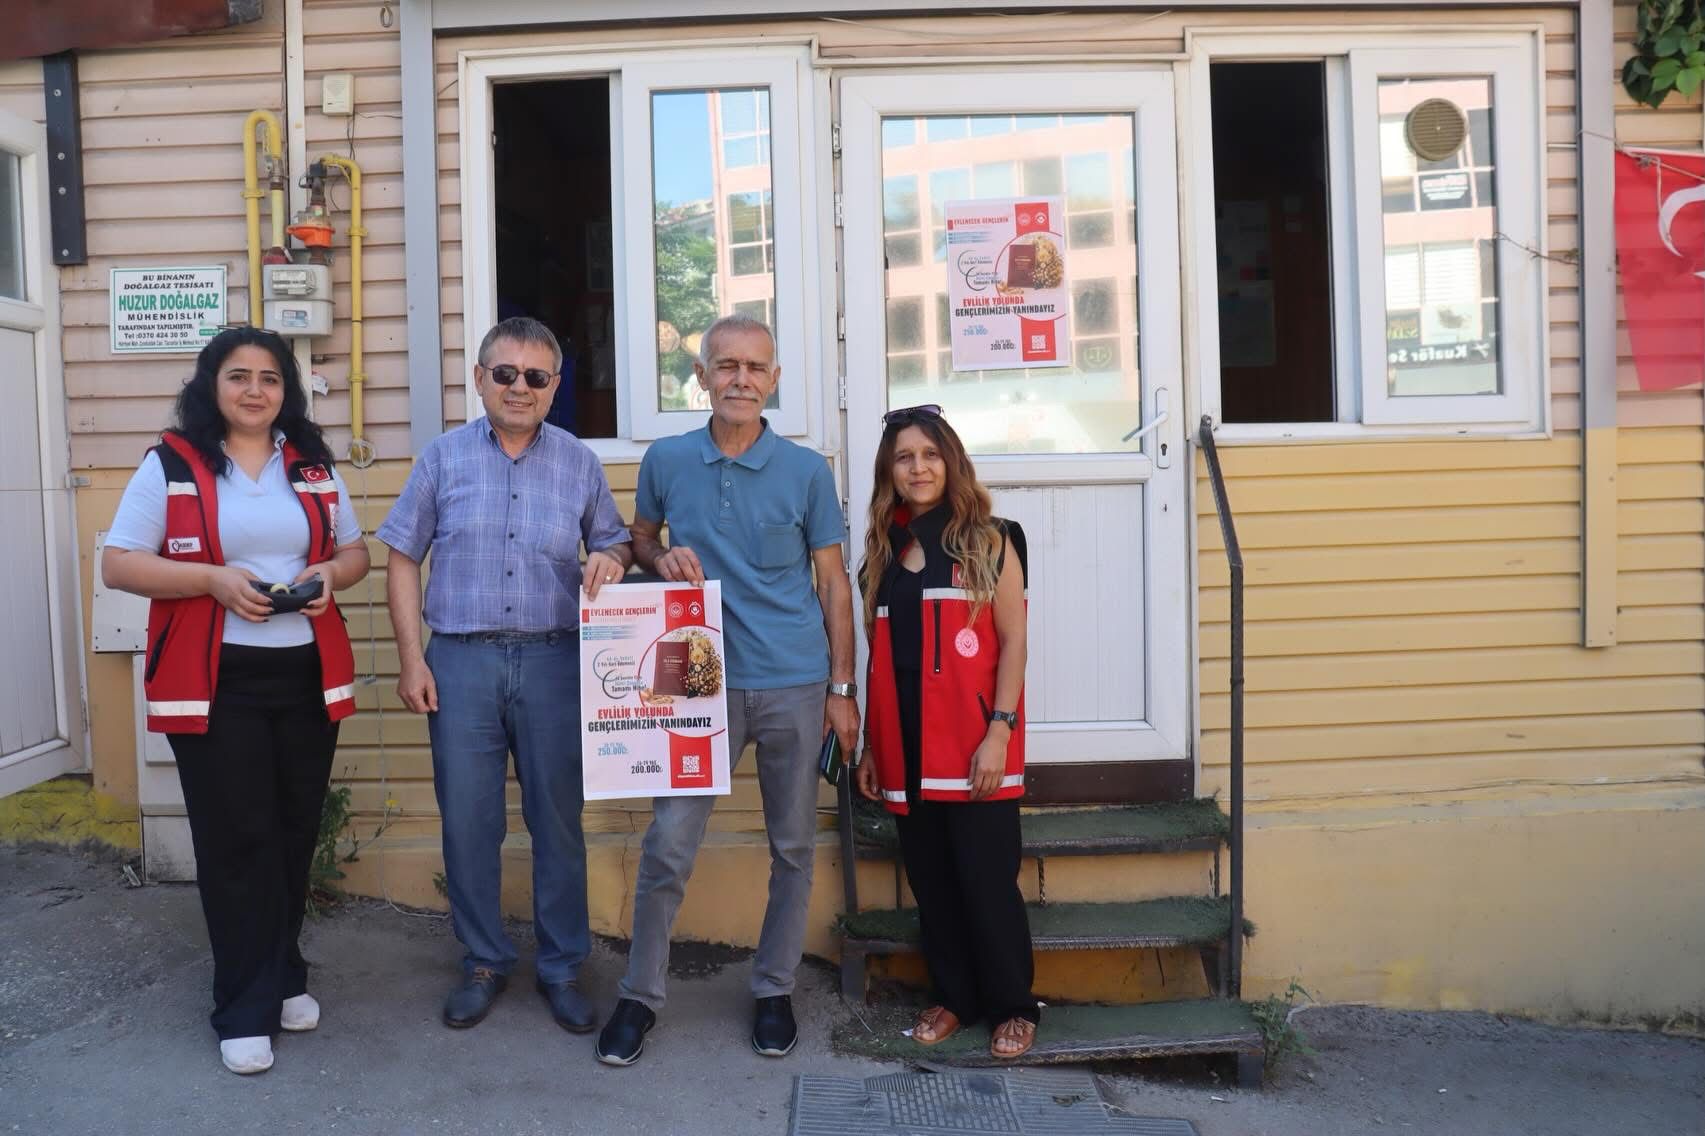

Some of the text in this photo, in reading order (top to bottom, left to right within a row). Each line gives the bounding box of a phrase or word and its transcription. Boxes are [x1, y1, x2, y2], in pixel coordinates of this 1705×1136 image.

[124, 281, 214, 290] DOĞALGAZ TESİSATI
[118, 291, 219, 311] HUZUR DOĞALGAZ
[963, 294, 1025, 307] EVLİLİK YOLUNDA
[128, 312, 205, 321] MÜHENDİSLİK
[955, 304, 1056, 319] GENÇLERİMİZİN YANINDAYIZ
[591, 606, 657, 617] EVLENECEK GENÇLERİN
[598, 706, 674, 719] EVLİLİK YOLUNDA
[588, 717, 711, 733] GENÇLERİMİZİN YANINDAYIZ
